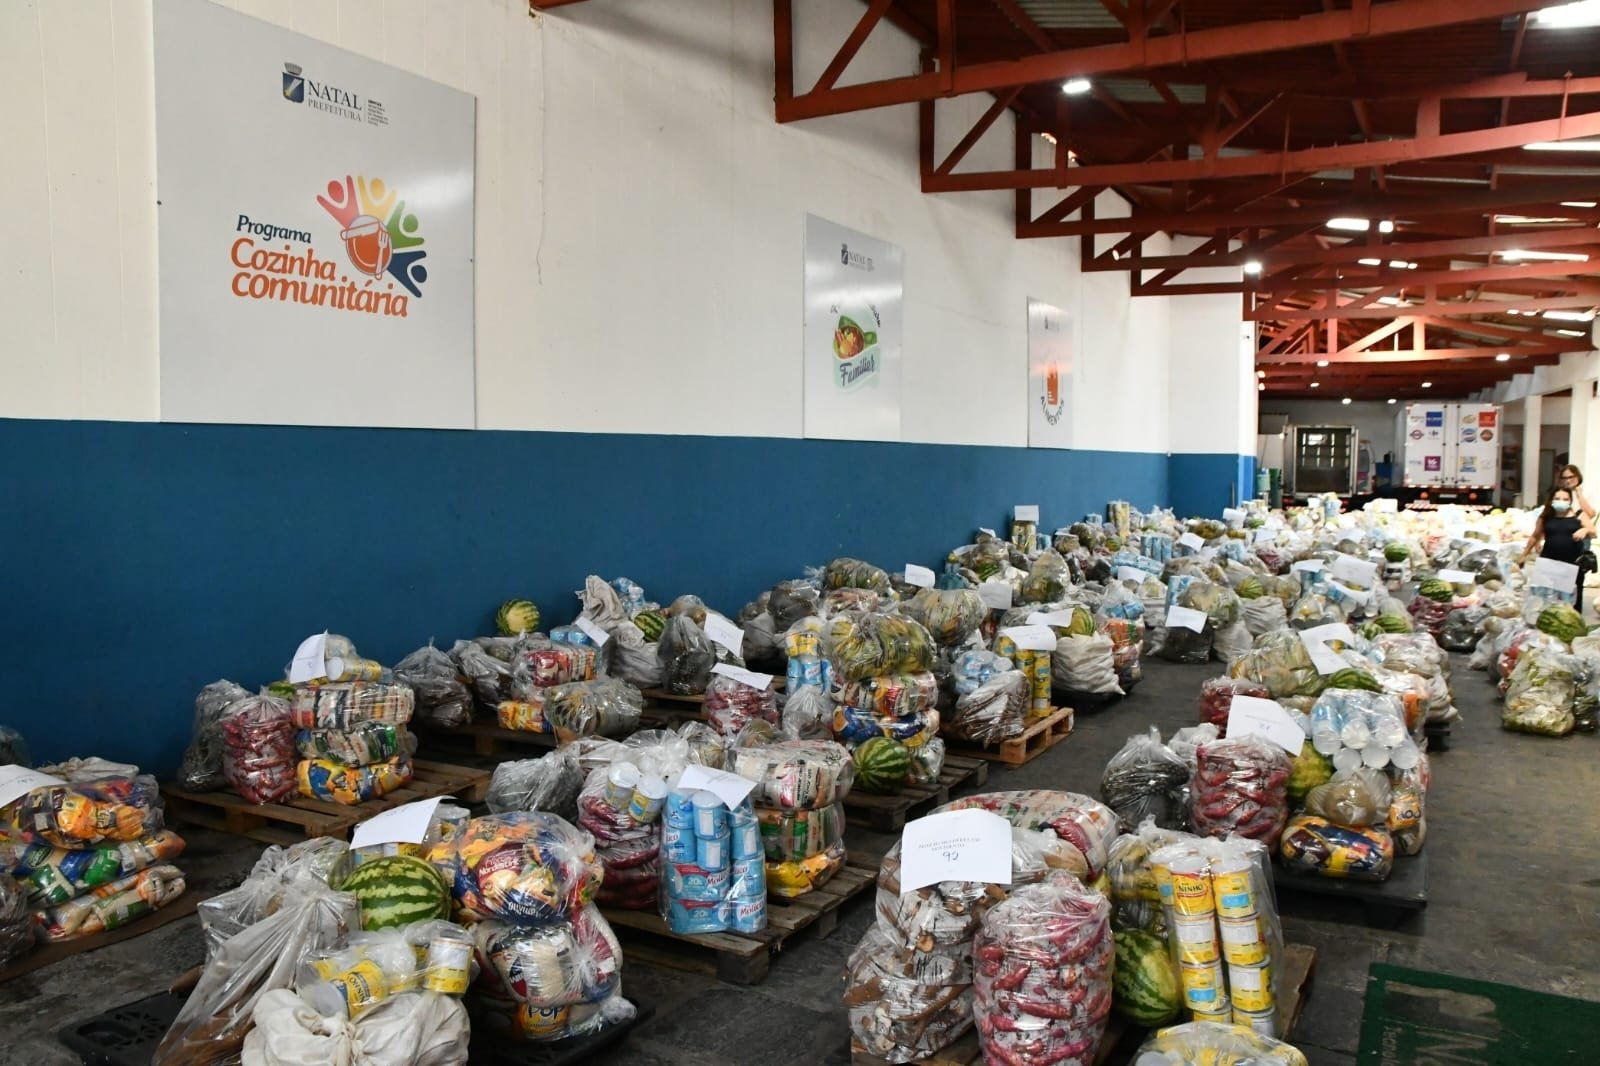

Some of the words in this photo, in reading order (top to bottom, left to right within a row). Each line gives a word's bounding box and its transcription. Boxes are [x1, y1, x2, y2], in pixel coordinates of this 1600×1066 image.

[308, 80, 362, 111] NATAL
[308, 98, 362, 122] PREFEITURA
[236, 214, 311, 243] Programa
[231, 237, 336, 282] Cozinha
[232, 272, 408, 317] comunitária
[1178, 882, 1203, 893] NINHO
